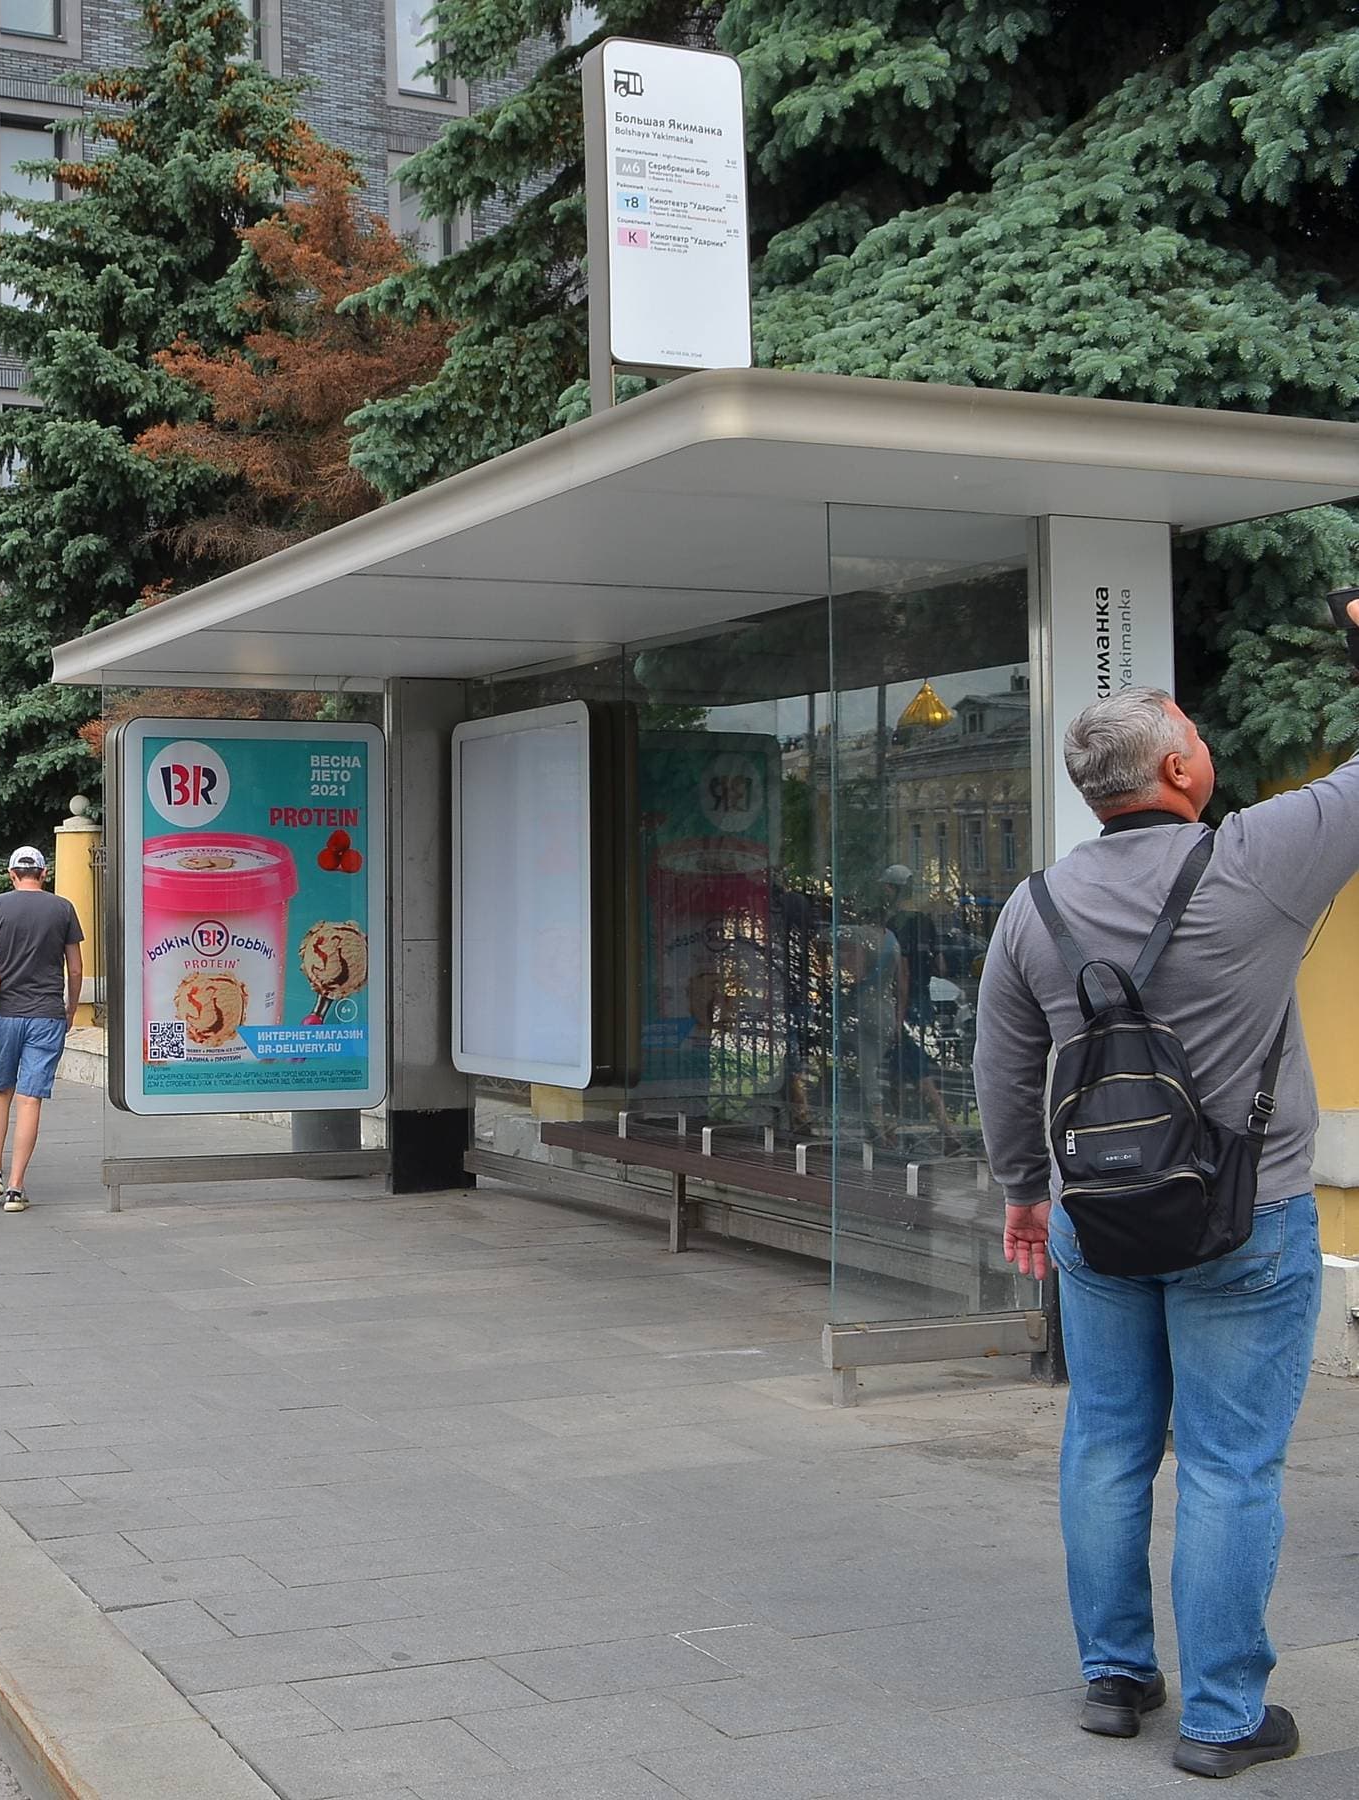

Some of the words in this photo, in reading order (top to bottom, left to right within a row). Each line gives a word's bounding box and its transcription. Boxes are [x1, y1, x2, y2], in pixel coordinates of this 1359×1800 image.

[615, 112, 665, 128] Большая
[668, 119, 722, 136] Якиманка
[615, 126, 650, 139] Bolshaya
[652, 131, 694, 144] Yakimanka
[648, 161, 694, 174] Серебряный
[696, 168, 710, 177] Бор
[649, 196, 688, 208] Кинотеатр
[650, 231, 689, 243] Кинотеатр
[1096, 586, 1110, 699] киманка
[1118, 589, 1132, 689] Yakimanka
[310, 755, 361, 768] ВЕСНА
[310, 769, 351, 782] ЛЕТО
[160, 764, 217, 806] BR
[310, 784, 346, 797] 2021
[269, 807, 359, 828] PROTEIN
[197, 929, 225, 947] BR
[184, 959, 236, 969] PROTEIN
[257, 1030, 363, 1041] ИНТЕРНЕТ-МАГАЗИН
[257, 1043, 341, 1054] BR-DELIVERY.RU
